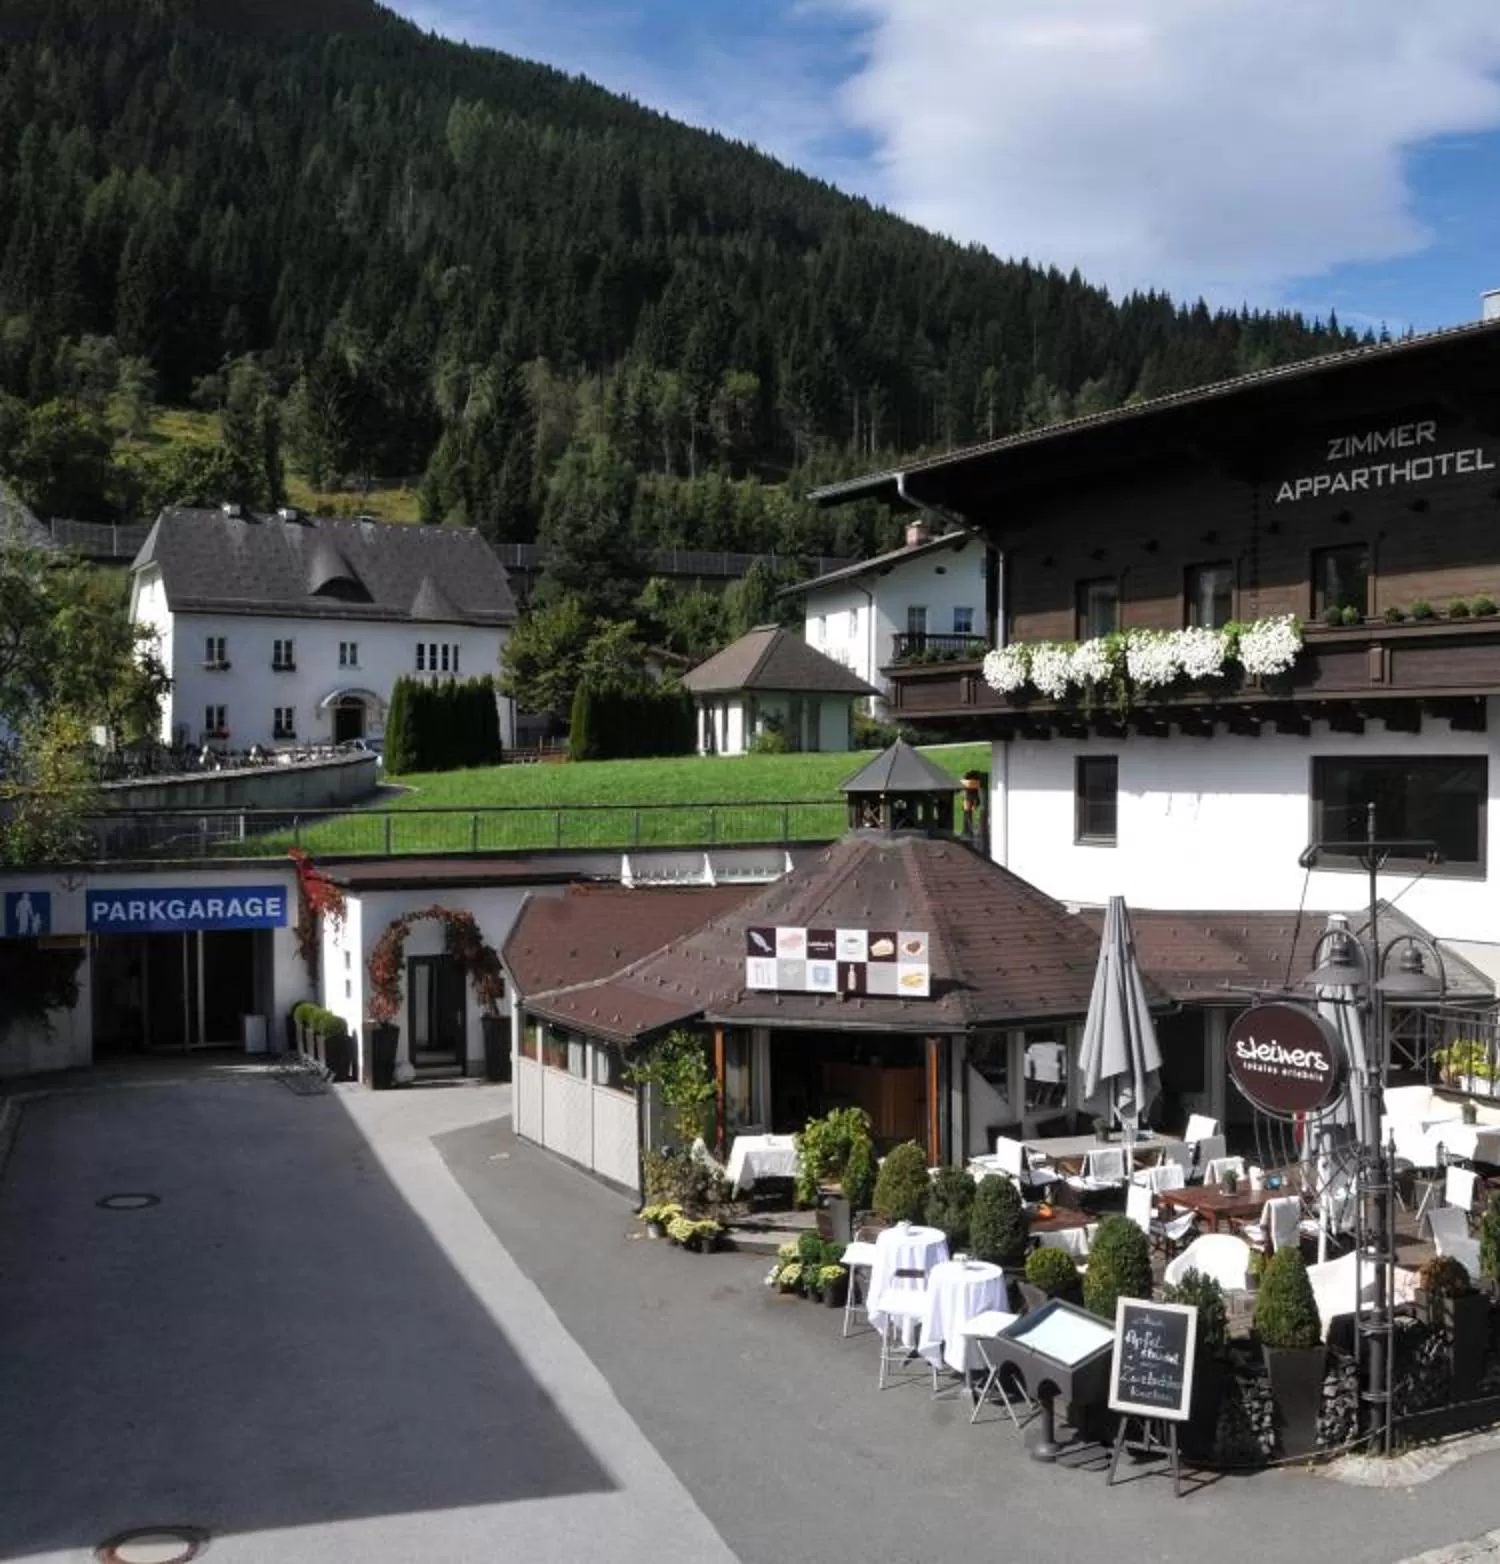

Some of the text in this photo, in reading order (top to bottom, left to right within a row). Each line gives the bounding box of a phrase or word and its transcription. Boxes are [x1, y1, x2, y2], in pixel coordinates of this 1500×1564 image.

[1327, 420, 1437, 461] ZIMMER
[1275, 447, 1496, 503] APPARTHOTEL
[91, 897, 282, 922] PARKGARAGE
[1236, 1036, 1329, 1071] steiners
